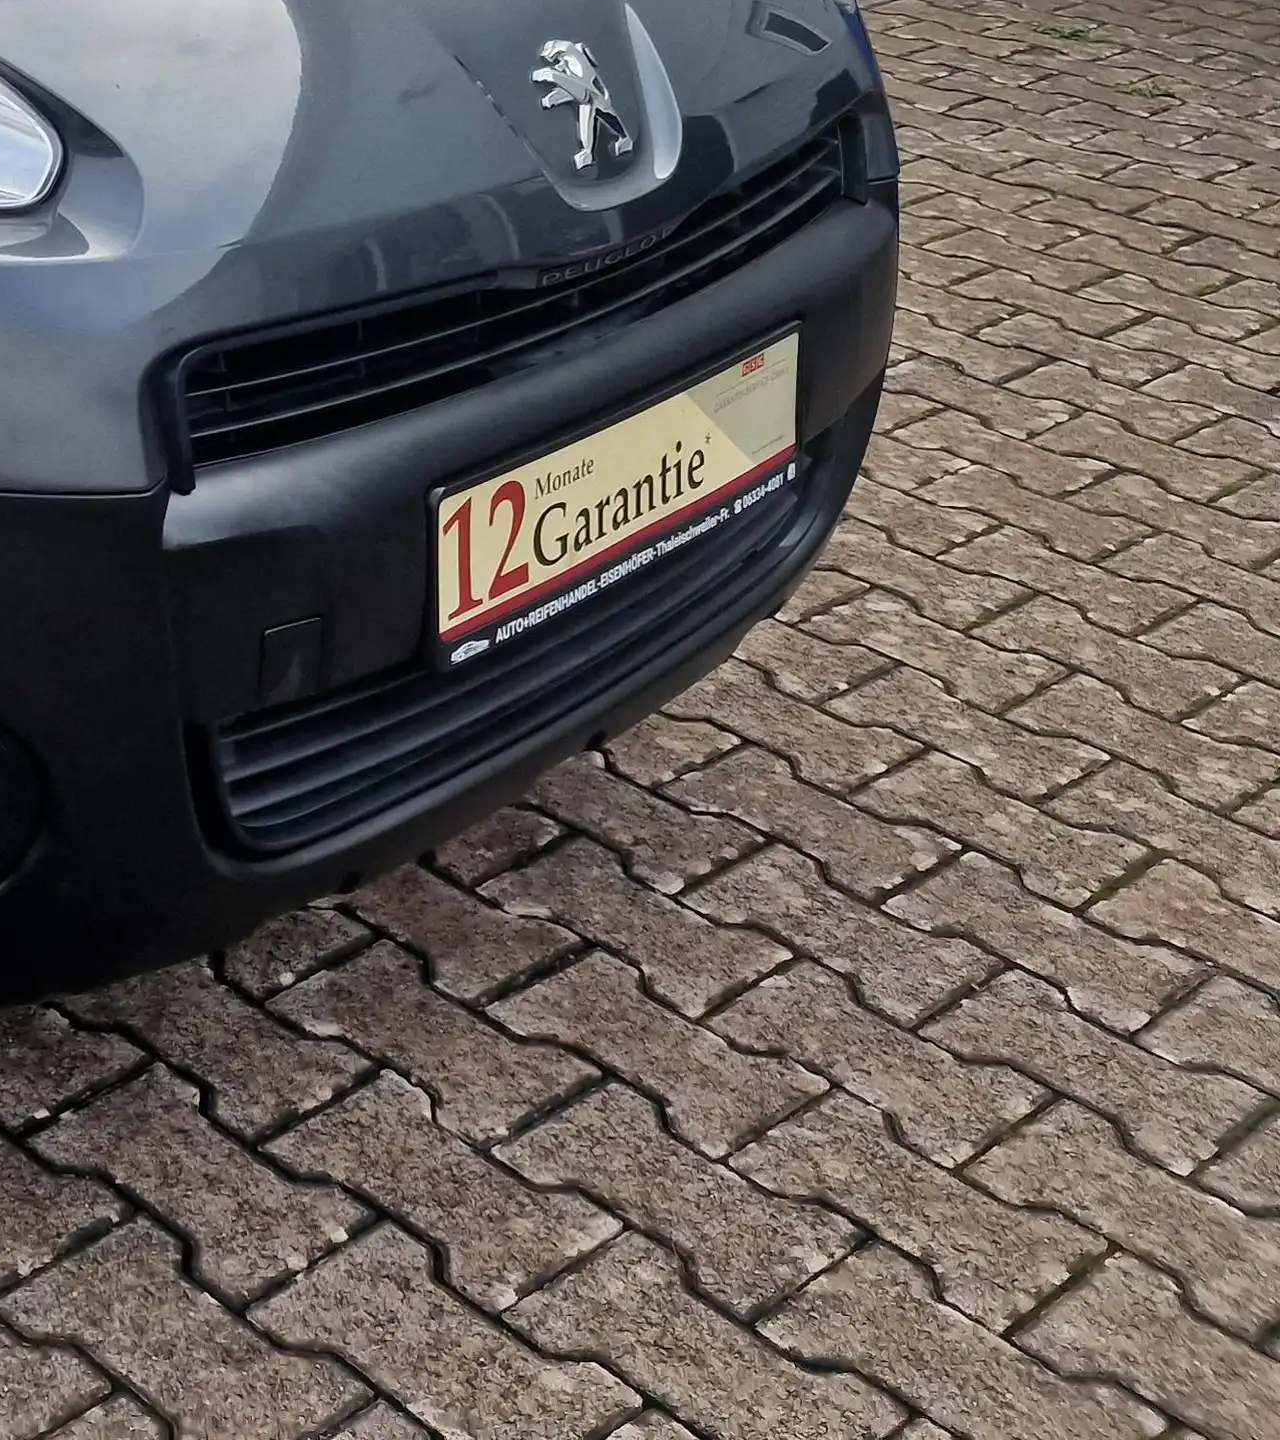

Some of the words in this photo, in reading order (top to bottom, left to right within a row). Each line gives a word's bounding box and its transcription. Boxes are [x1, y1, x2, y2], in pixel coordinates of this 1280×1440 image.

[533, 440, 706, 567] Garantie
[535, 457, 595, 500] Monate
[443, 480, 530, 621] 12
